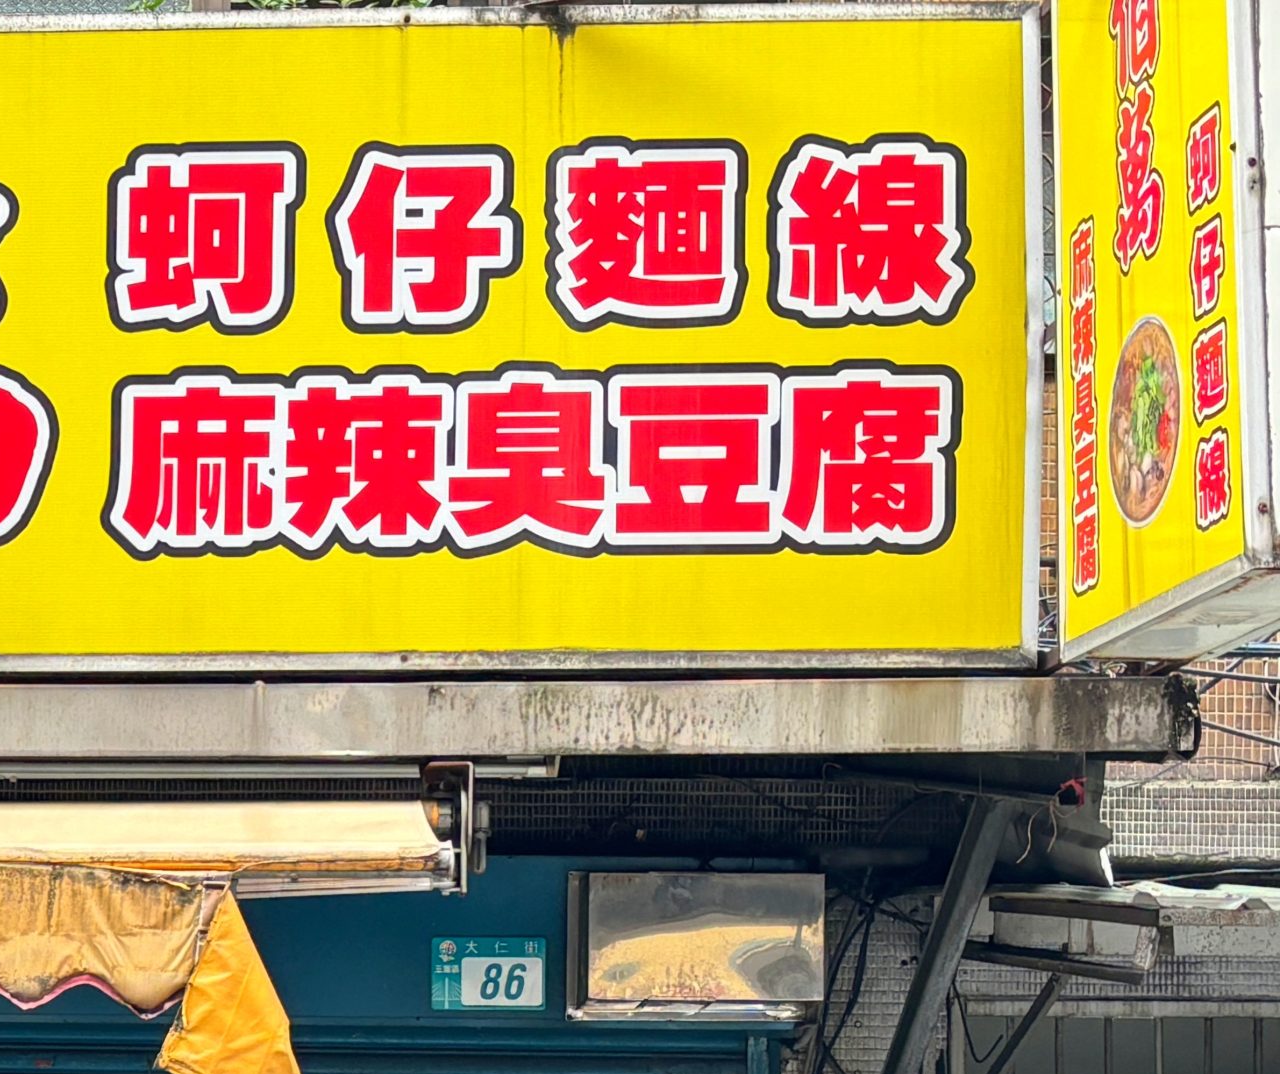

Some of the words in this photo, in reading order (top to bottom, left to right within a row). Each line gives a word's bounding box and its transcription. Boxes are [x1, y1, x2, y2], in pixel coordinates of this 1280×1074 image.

[108, 137, 976, 334] 蚵仔麵線
[1186, 100, 1232, 532] 蚵仔麵線
[102, 361, 962, 559] 麻辣臭豆腐
[464, 940, 539, 955] 大仁街
[479, 962, 528, 1001] 86
